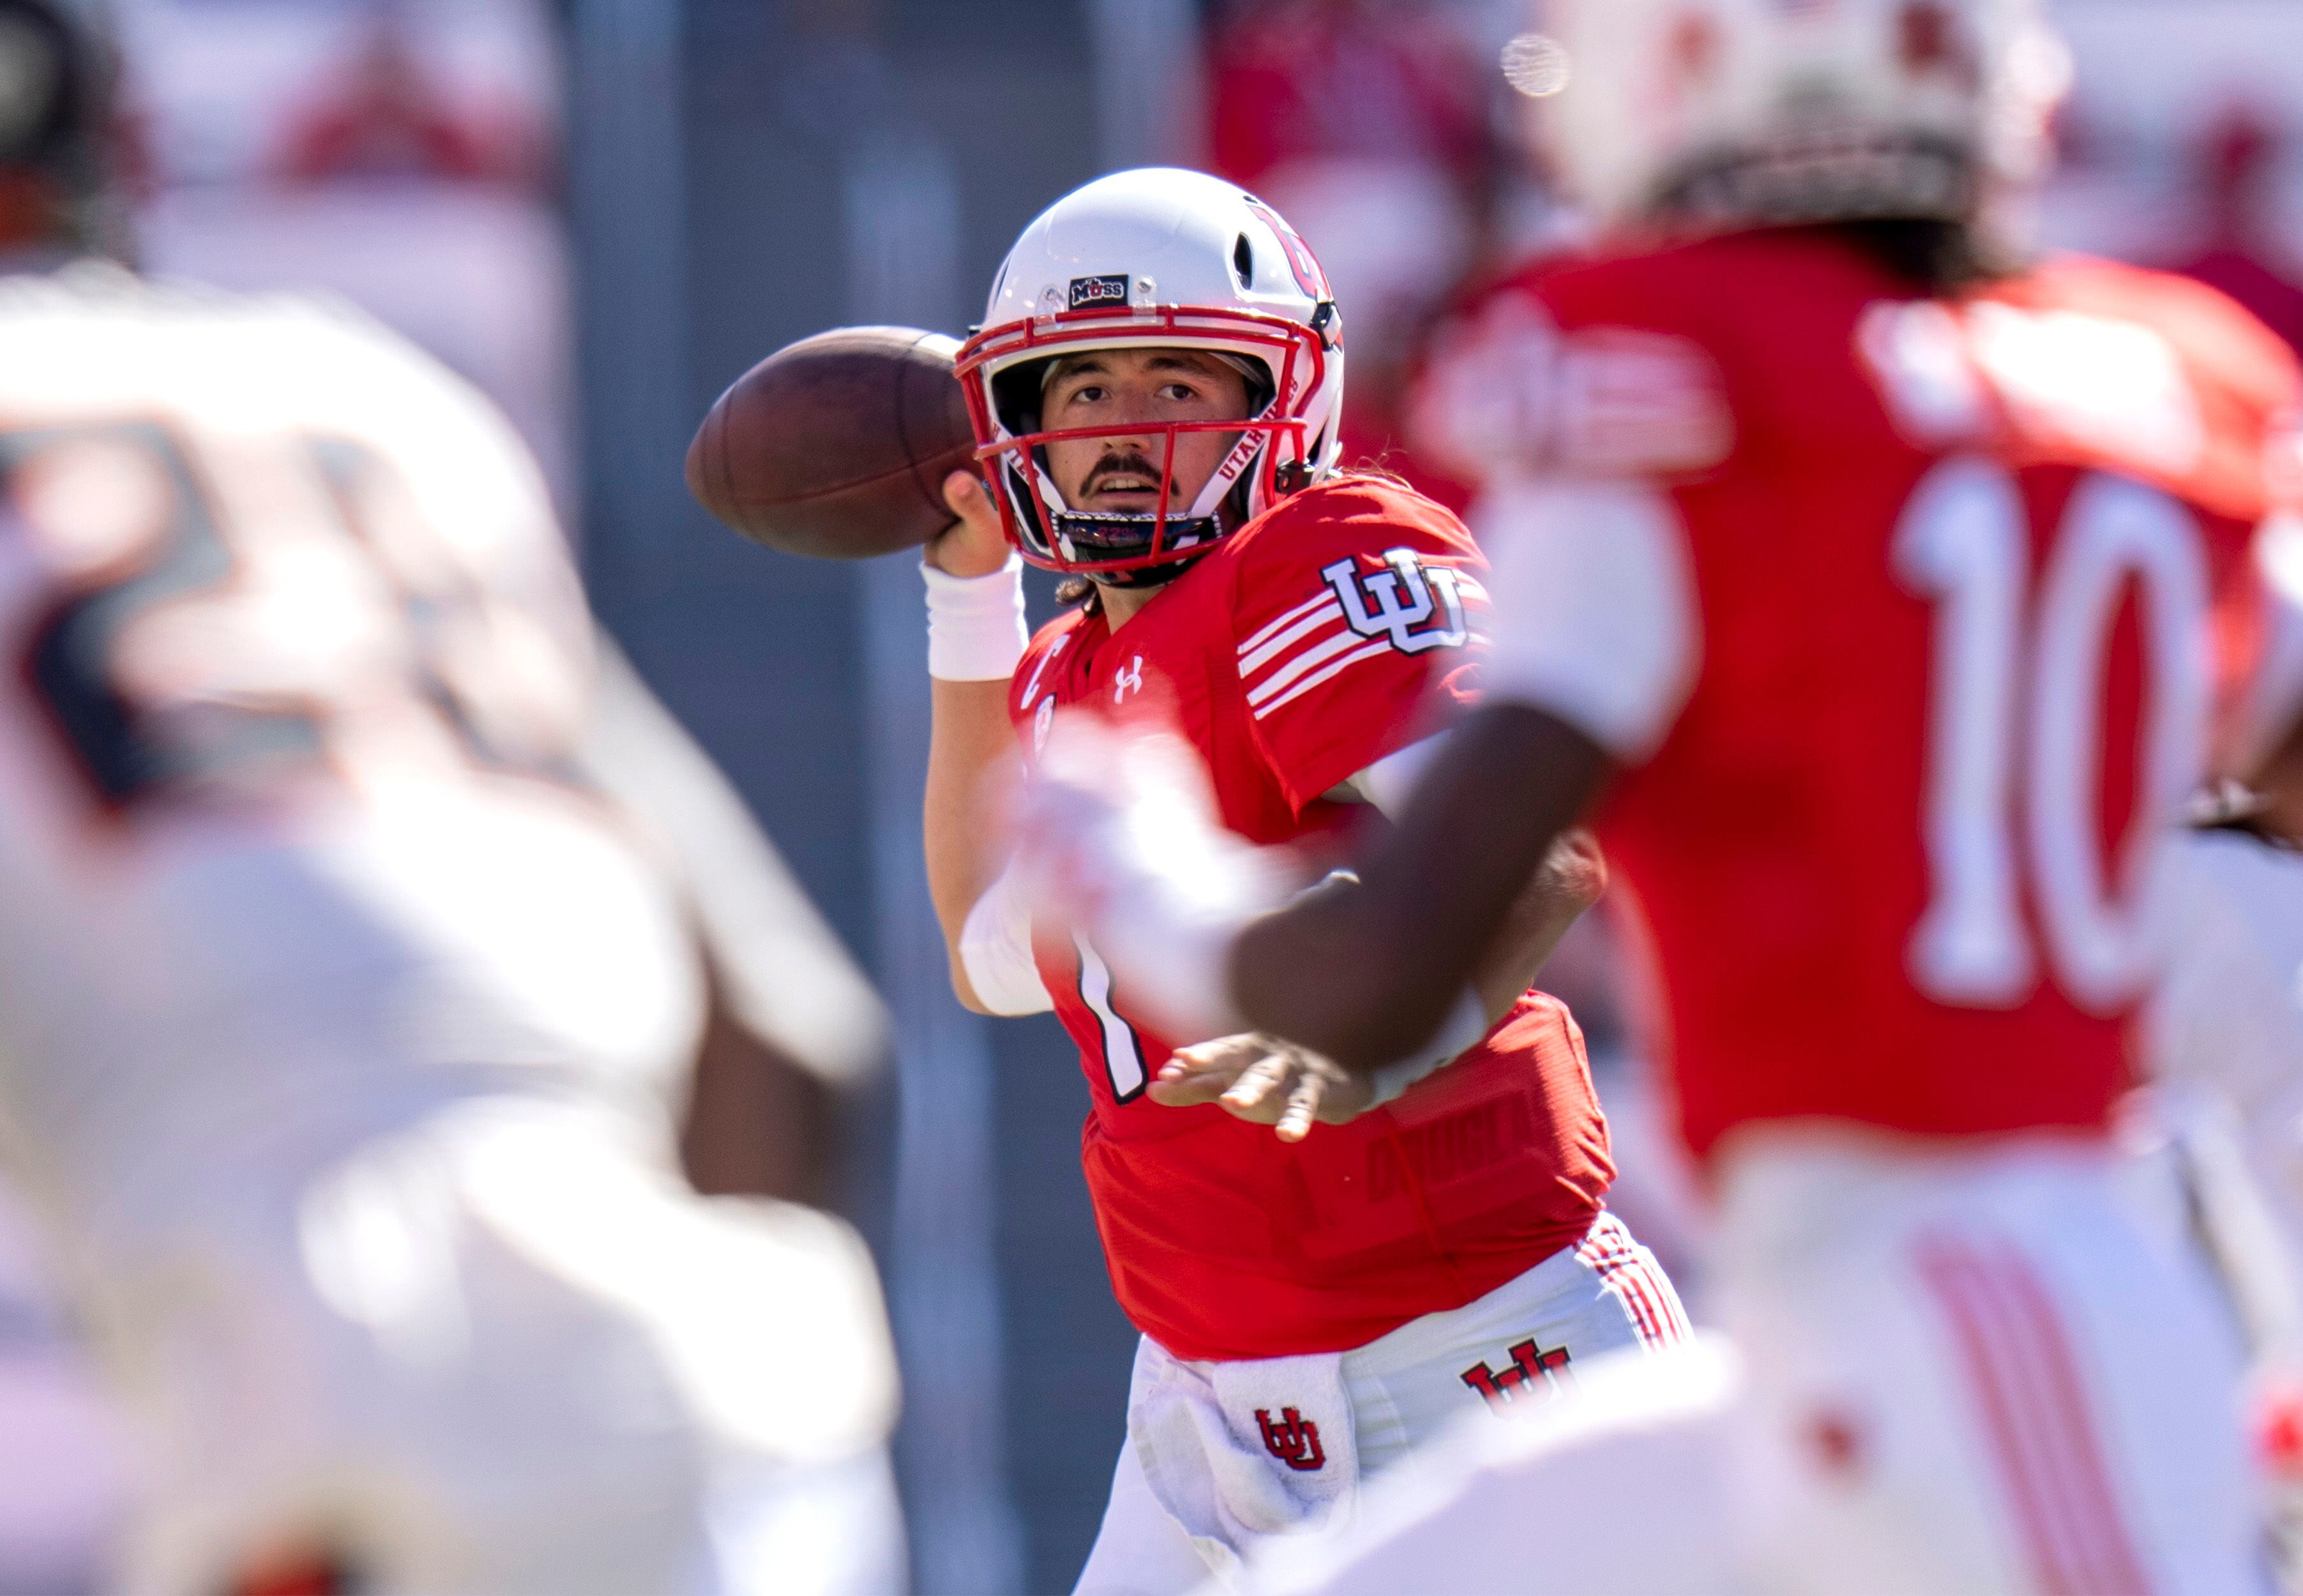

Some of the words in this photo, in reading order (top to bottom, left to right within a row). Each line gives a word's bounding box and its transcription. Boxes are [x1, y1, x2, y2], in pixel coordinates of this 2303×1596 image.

[1072, 281, 1124, 305] MUSS
[1218, 428, 1265, 481] UTAH
[1893, 456, 2206, 1018] 10
